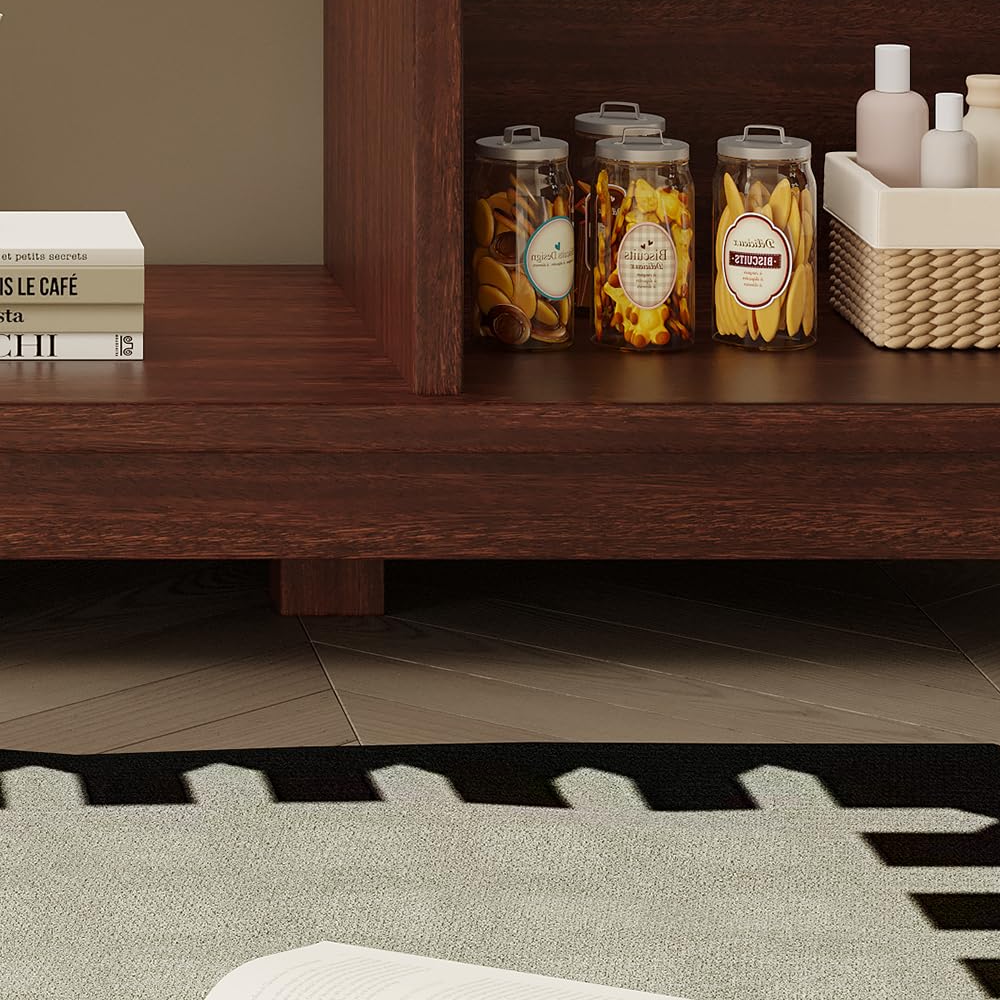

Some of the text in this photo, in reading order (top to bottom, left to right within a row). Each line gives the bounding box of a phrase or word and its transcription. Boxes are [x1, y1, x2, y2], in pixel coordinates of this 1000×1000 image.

[2, 252, 88, 262] et petits secrets
[18, 277, 35, 296] LE
[40, 273, 78, 296] CAFÉ
